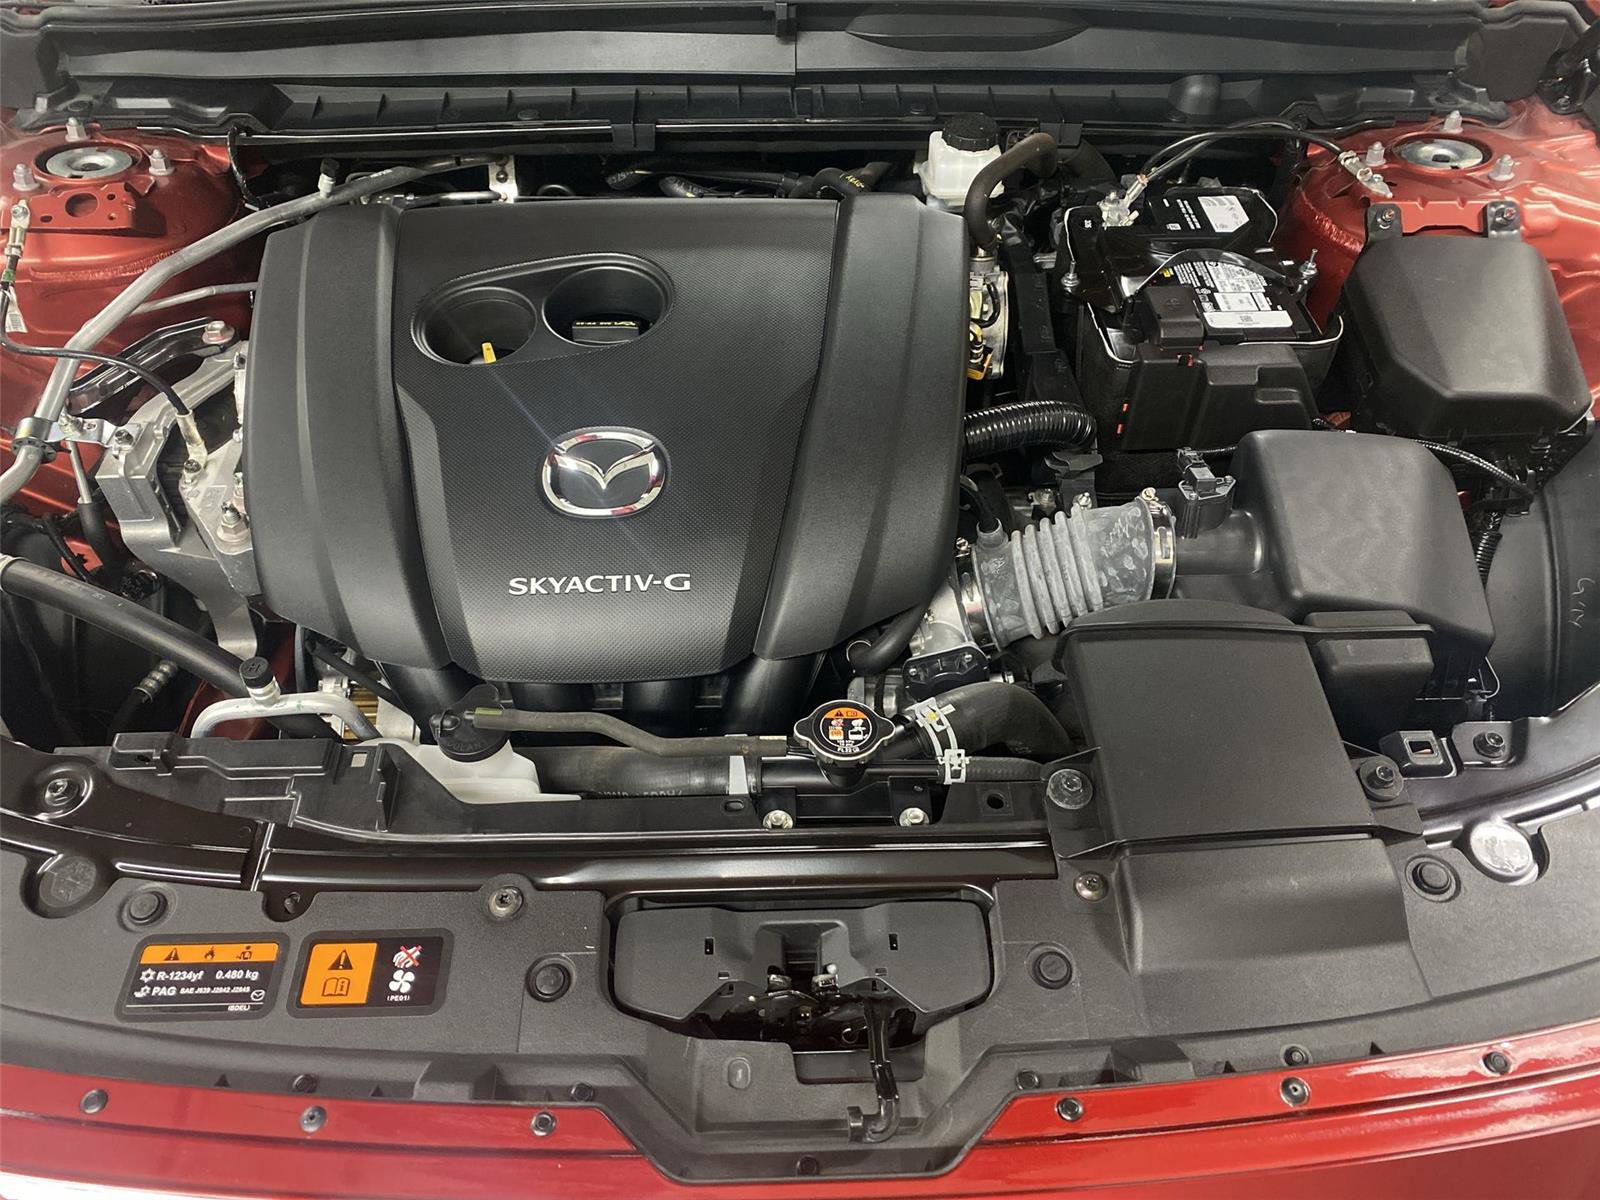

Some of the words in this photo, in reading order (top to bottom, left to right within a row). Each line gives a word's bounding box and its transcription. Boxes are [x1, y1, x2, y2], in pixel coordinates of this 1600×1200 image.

[508, 573, 691, 596] SKYACTIV-G
[156, 970, 204, 982] R-1234yf
[215, 970, 244, 980] 0.480
[245, 970, 259, 981] kg
[152, 986, 177, 996] PAG
